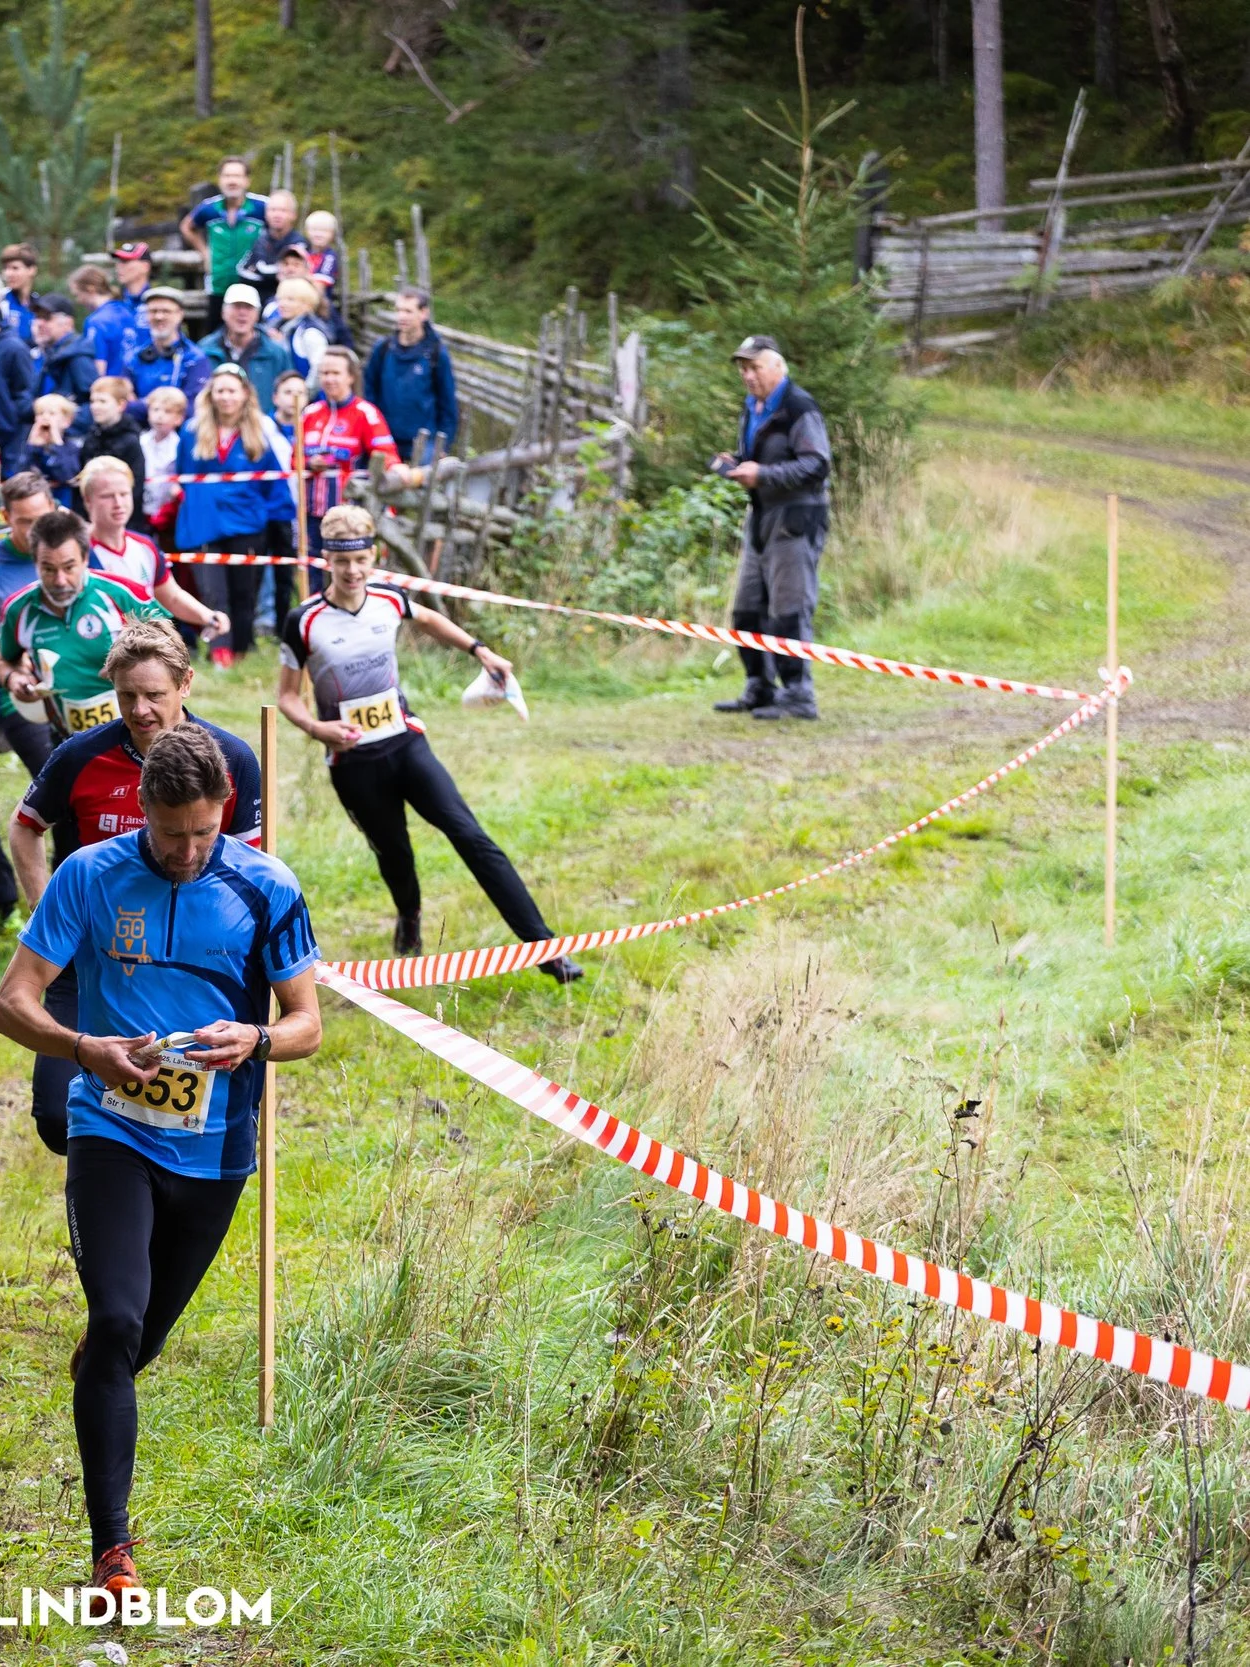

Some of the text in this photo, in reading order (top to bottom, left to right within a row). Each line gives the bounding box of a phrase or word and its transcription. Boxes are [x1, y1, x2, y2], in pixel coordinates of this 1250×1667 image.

[69, 702, 114, 730] 355
[352, 700, 392, 729] 164
[107, 1097, 119, 1107] Str
